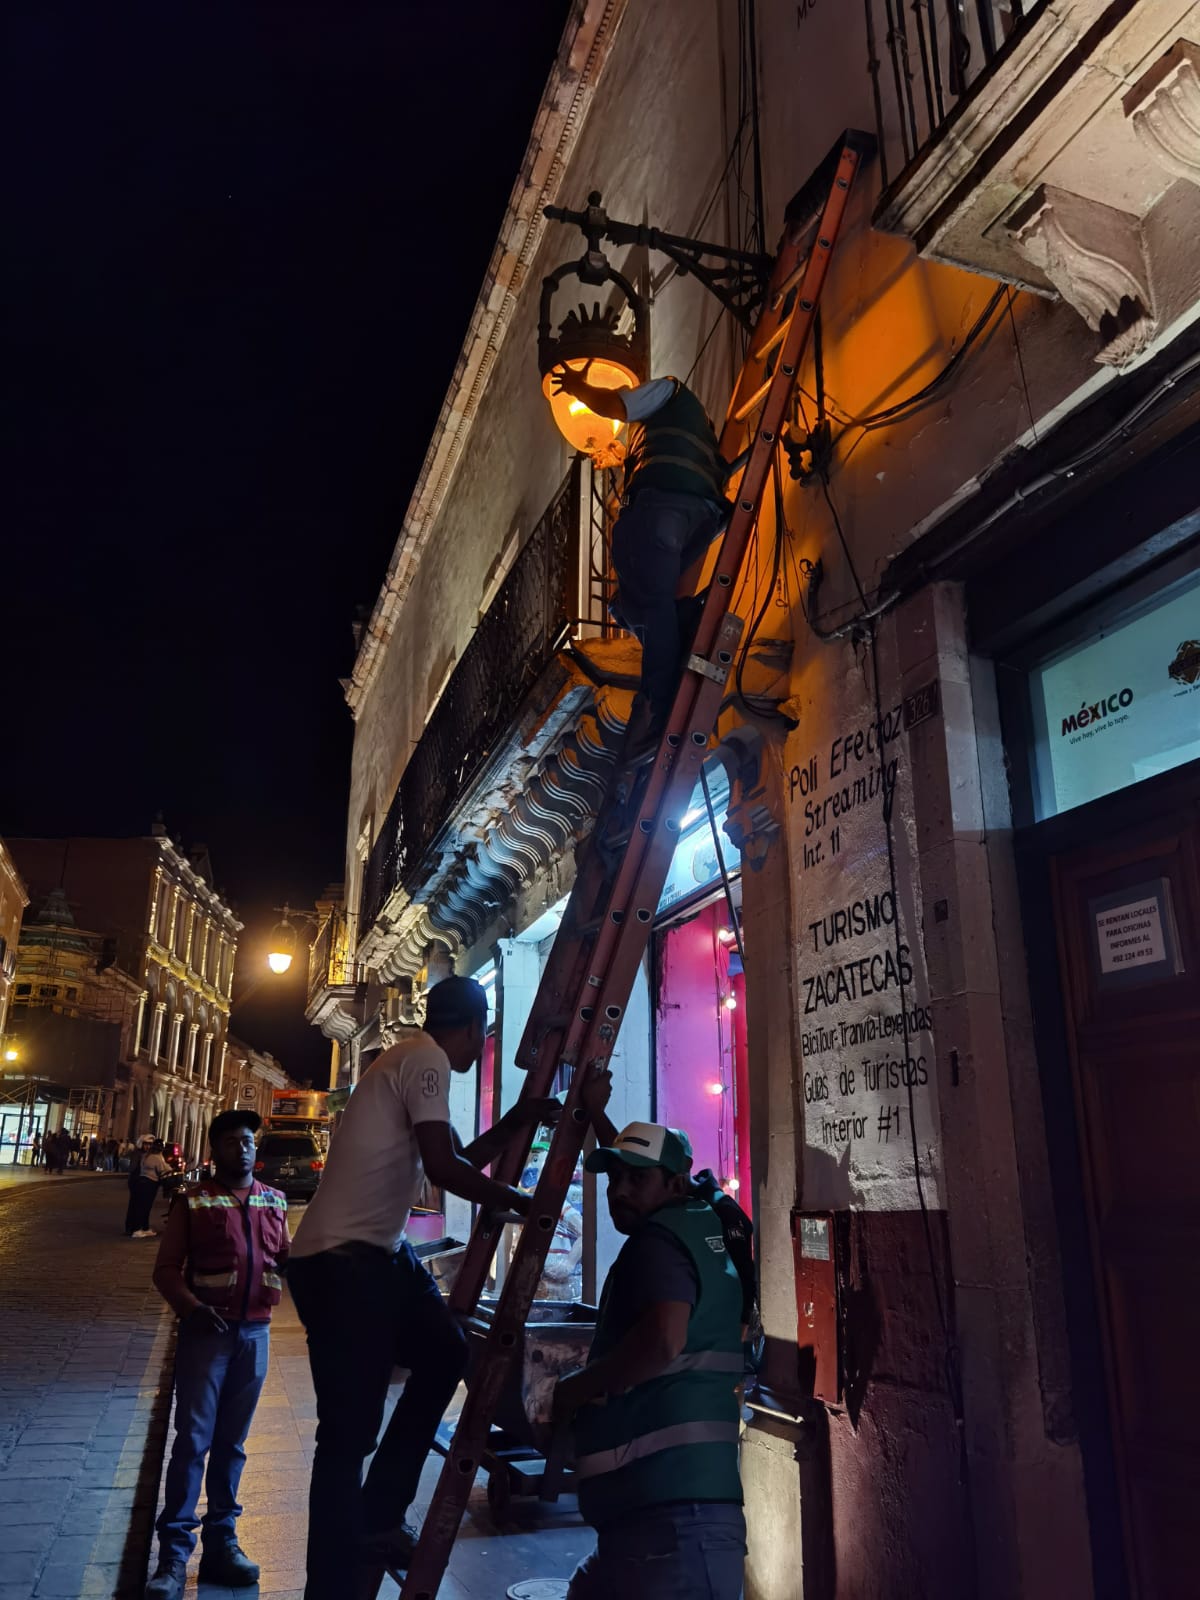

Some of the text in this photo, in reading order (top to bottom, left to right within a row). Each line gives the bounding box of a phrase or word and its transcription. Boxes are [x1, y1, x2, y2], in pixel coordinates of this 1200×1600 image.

[790, 755, 817, 803] Poli
[805, 757, 898, 837] Streaming
[804, 826, 840, 870] Int. 11
[808, 891, 895, 952] TURISMO
[1105, 912, 1130, 925] RENTAN
[1130, 905, 1157, 918] LOCALES
[1106, 920, 1151, 938] PARA OFICINAS
[1110, 934, 1151, 950] INFORMES AL
[802, 944, 913, 1014] ZACATECAS
[244, 1087, 253, 1098] E
[422, 1068, 439, 1098] 3
[839, 1065, 855, 1096] de
[862, 1053, 928, 1091] Turistas
[821, 1105, 900, 1144] Interior #1
